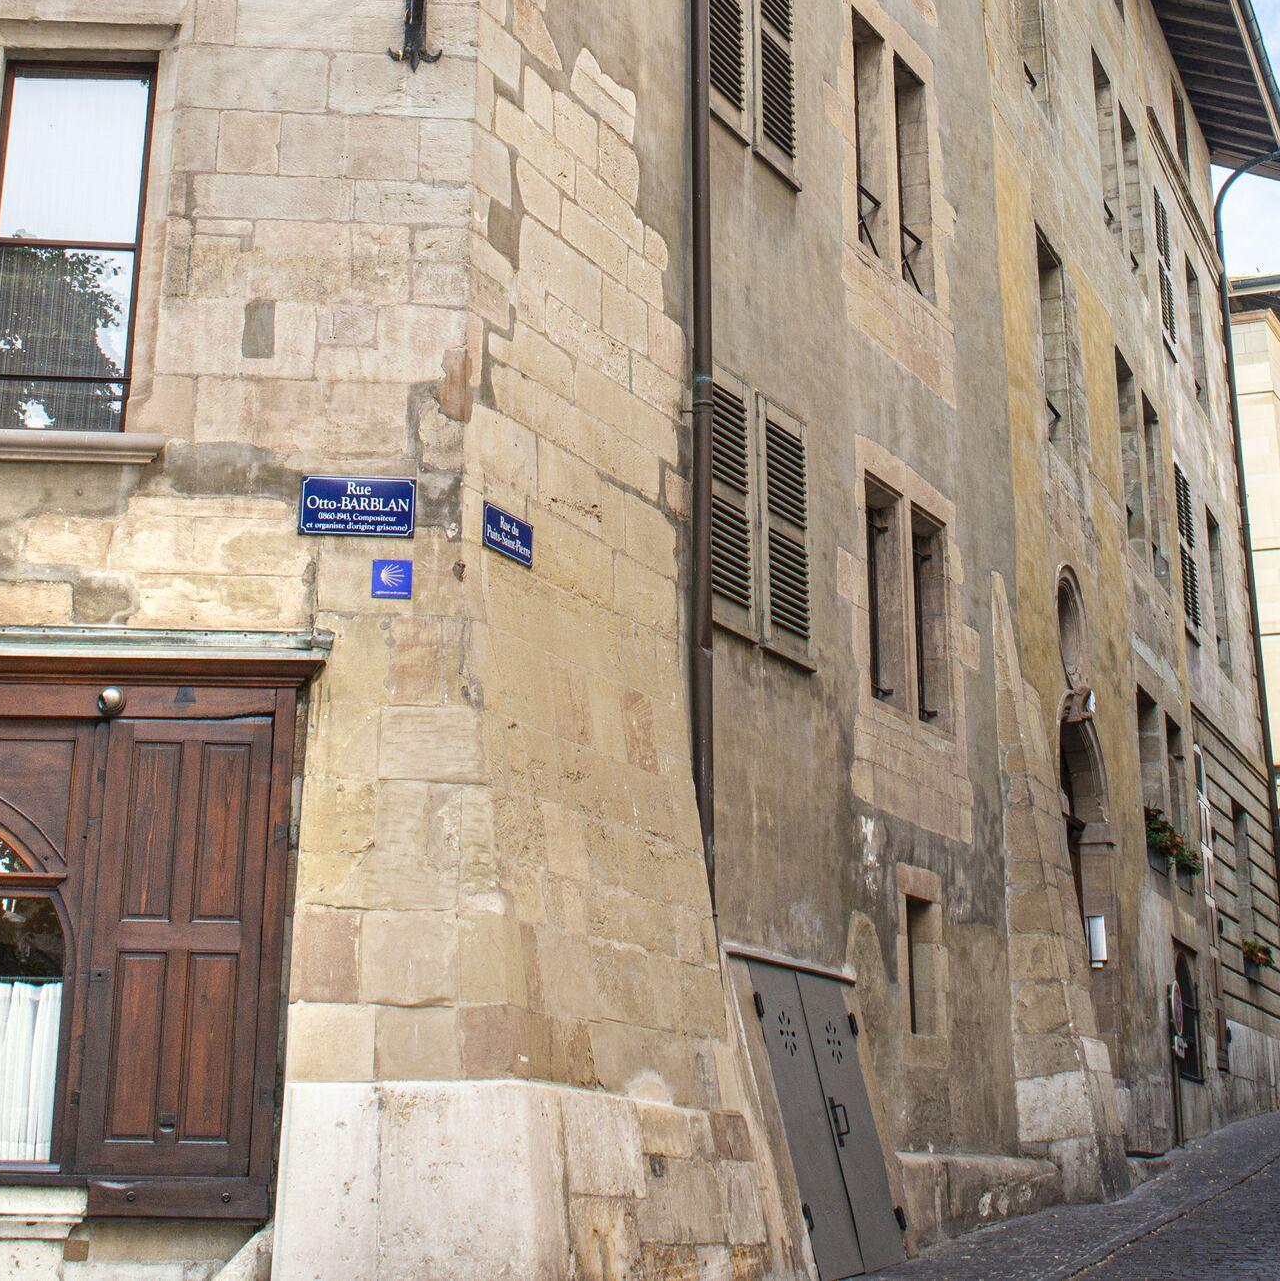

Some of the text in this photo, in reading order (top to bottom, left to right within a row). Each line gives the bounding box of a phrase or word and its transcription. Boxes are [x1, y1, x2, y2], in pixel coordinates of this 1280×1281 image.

[346, 481, 372, 495] Rue
[306, 495, 410, 512] Otto-BARBLAN
[352, 512, 397, 522] Compositeur
[314, 522, 346, 531] organiste
[346, 522, 376, 531] d'origine
[500, 515, 519, 537] Rue du
[486, 523, 531, 558] Puits-Saint-Pierre
